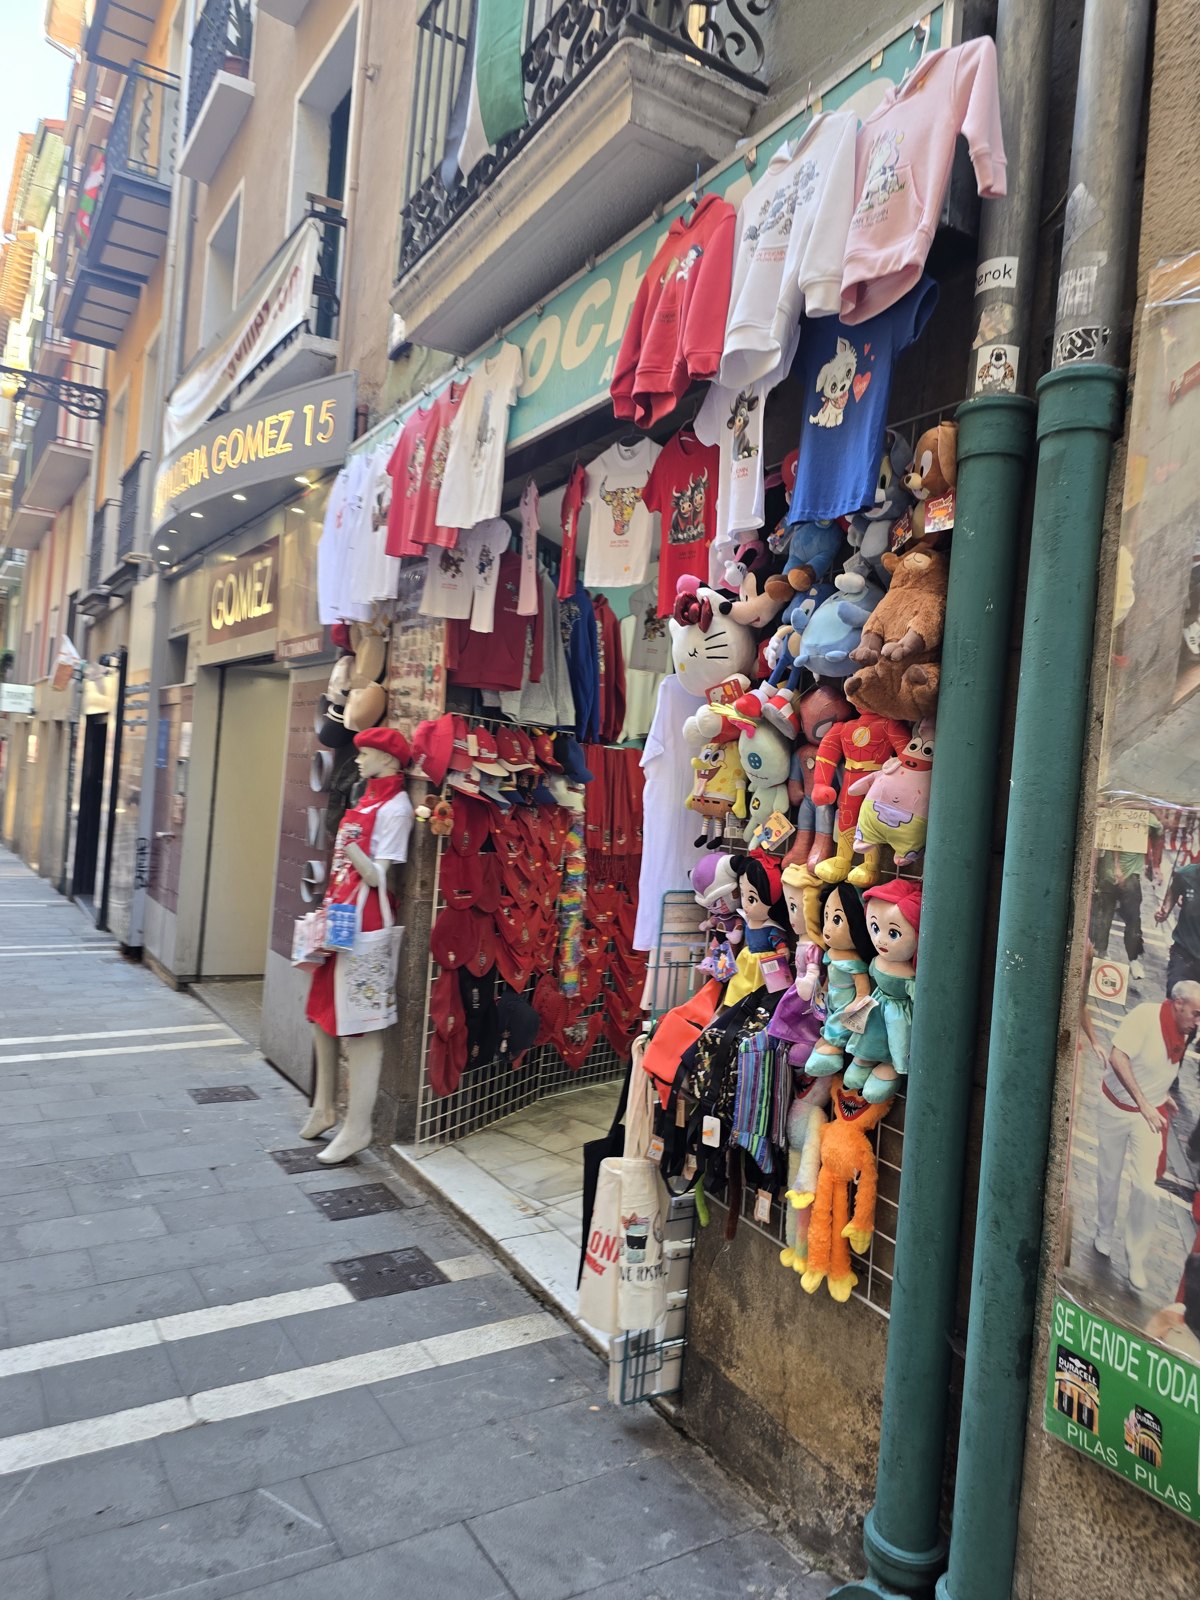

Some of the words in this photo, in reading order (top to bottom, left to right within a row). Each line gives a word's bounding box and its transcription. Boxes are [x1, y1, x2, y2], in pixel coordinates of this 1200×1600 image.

[211, 410, 295, 475] GOMEZ
[303, 399, 337, 446] 15
[211, 556, 273, 630] GOMEZ
[1055, 1302, 1075, 1345] SE
[1080, 1315, 1141, 1381] VENDE
[1146, 1349, 1199, 1414] TODA
[1058, 1355, 1097, 1386] DURACELL
[1135, 1411, 1161, 1433] DURACELL
[1067, 1422, 1118, 1468] PILAS
[1135, 1463, 1192, 1513] PILAS
